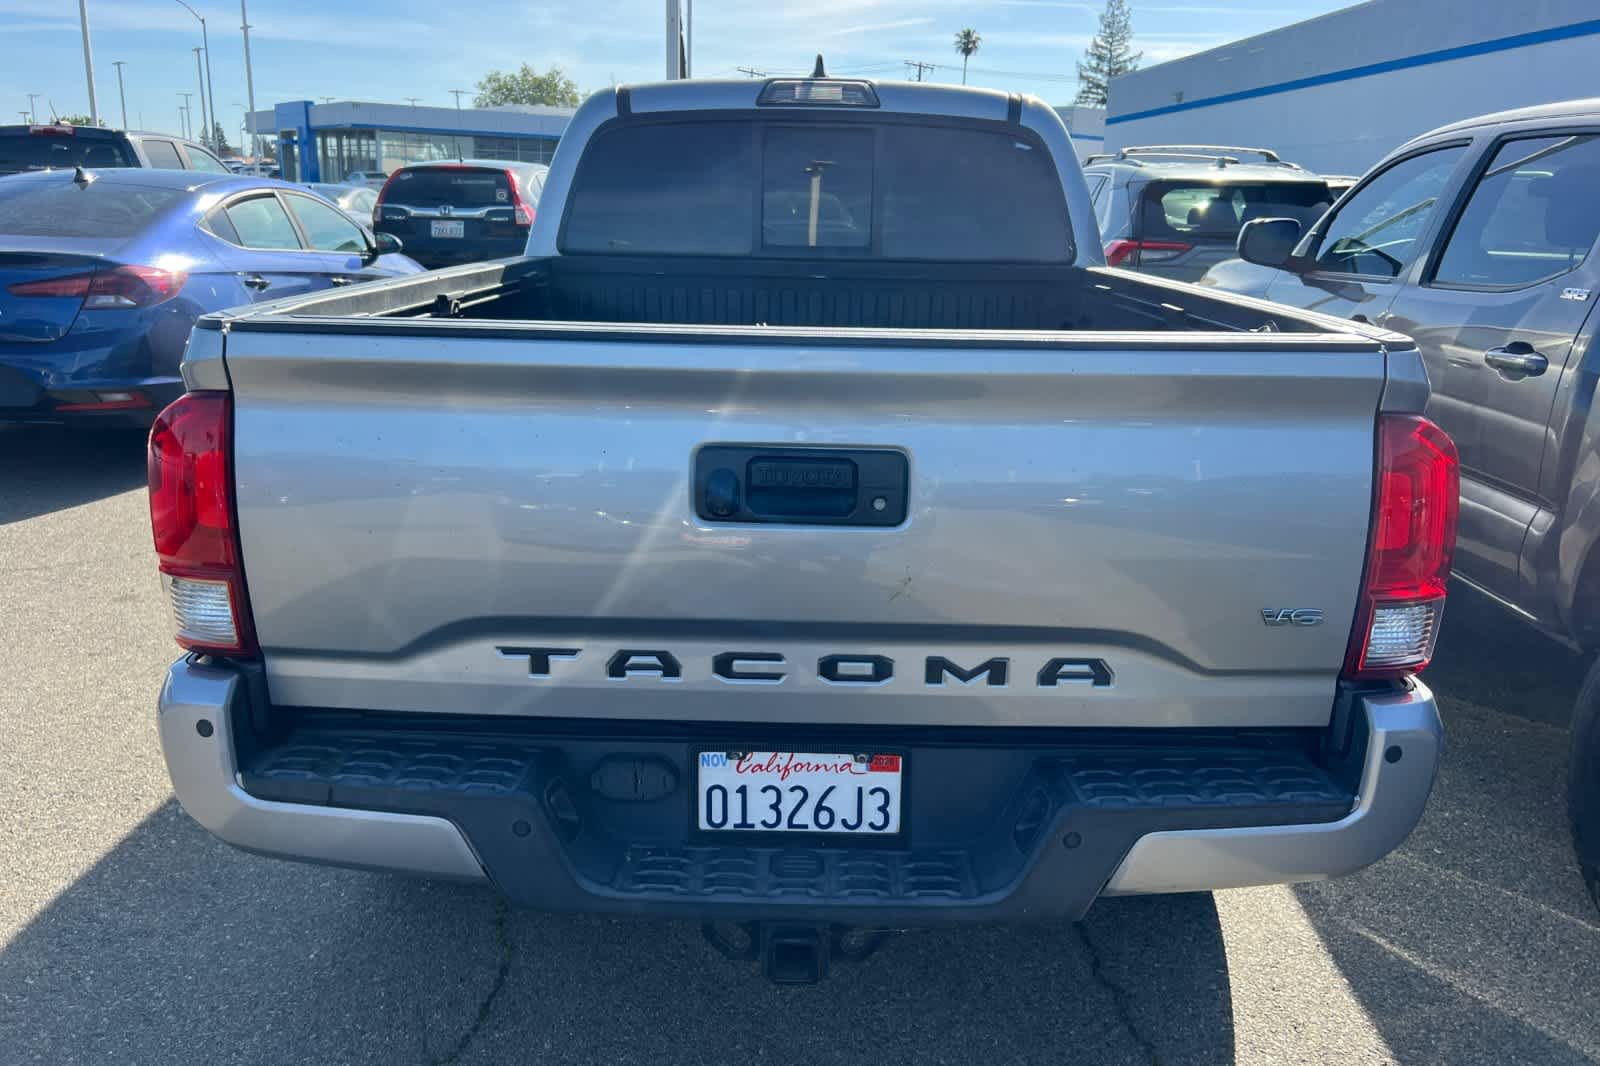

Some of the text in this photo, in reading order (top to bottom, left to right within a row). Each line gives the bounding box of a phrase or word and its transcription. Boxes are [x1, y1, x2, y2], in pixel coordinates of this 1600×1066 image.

[1262, 608, 1323, 625] V6
[495, 645, 1115, 689] TACOMA
[701, 753, 728, 768] NOV
[736, 752, 866, 781] California
[705, 784, 890, 831] 01326J3
